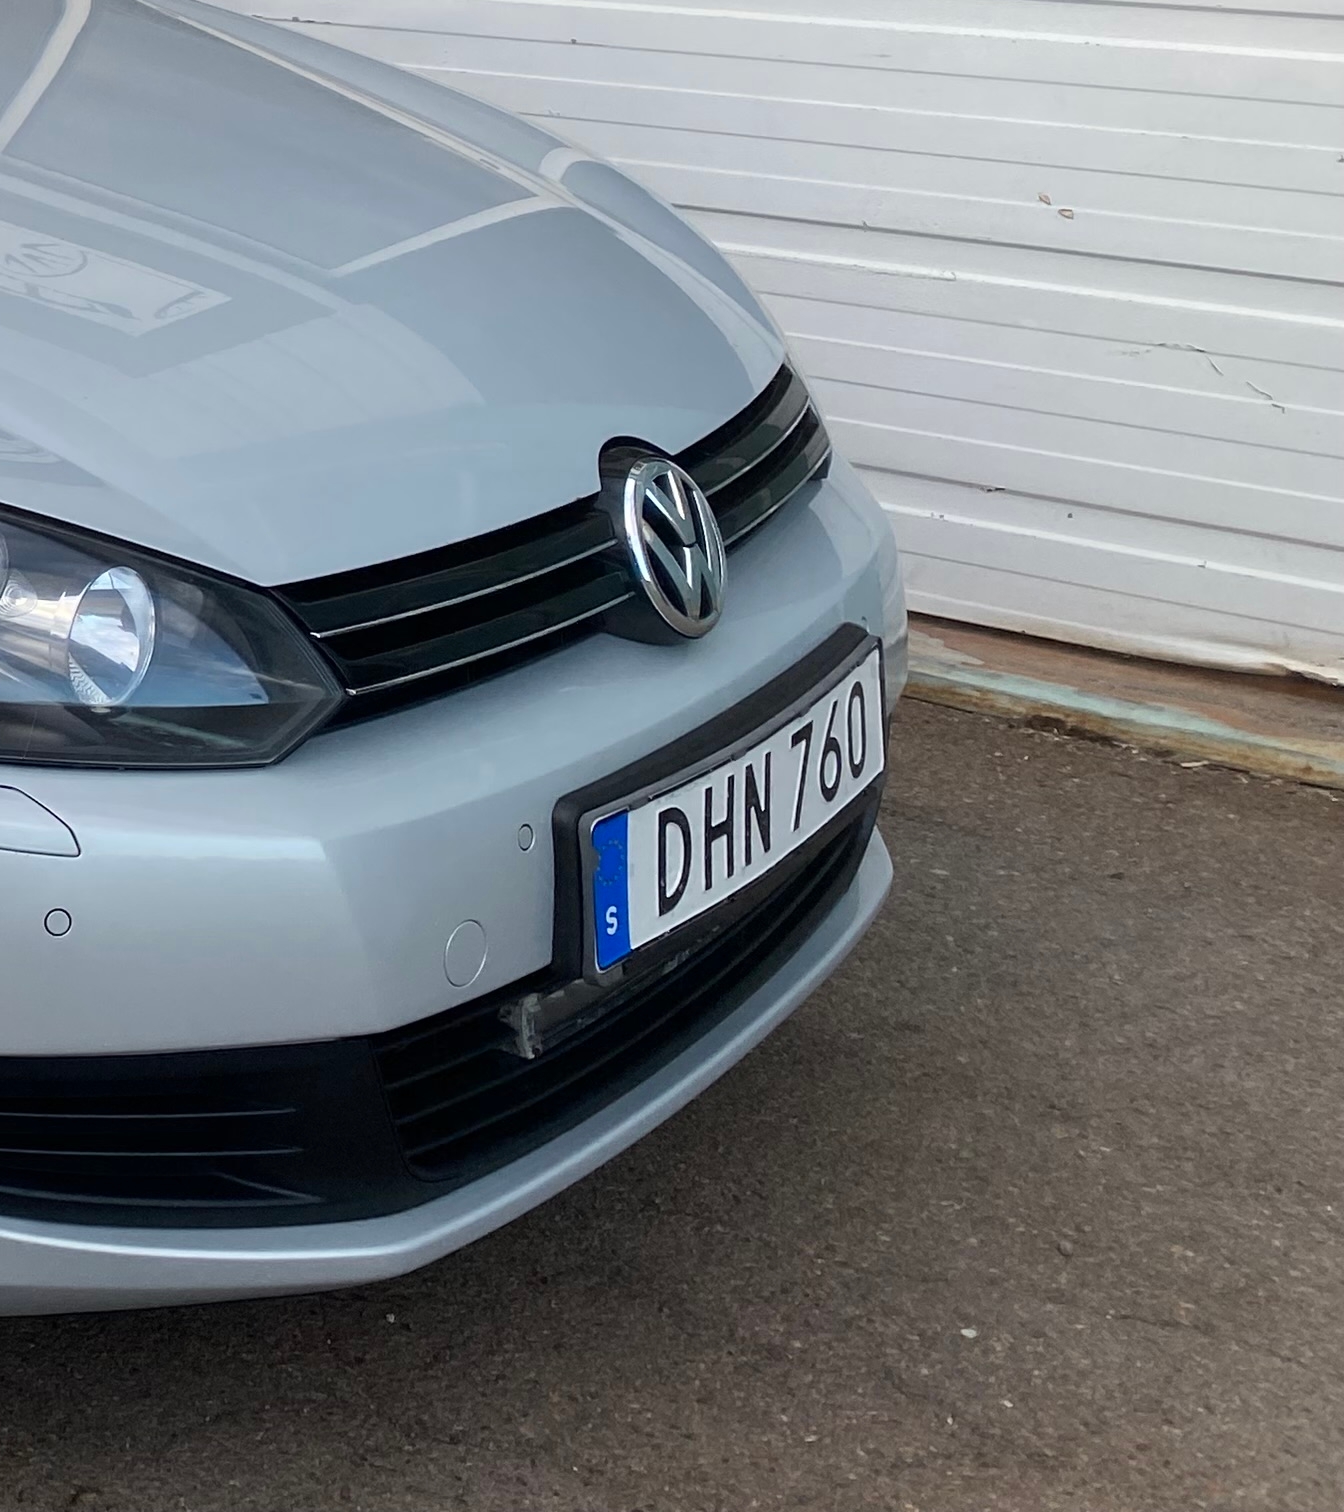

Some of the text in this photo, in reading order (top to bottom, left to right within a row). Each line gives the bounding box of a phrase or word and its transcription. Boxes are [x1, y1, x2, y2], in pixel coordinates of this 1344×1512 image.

[657, 680, 866, 917] DHN 760
[605, 905, 618, 936] S
